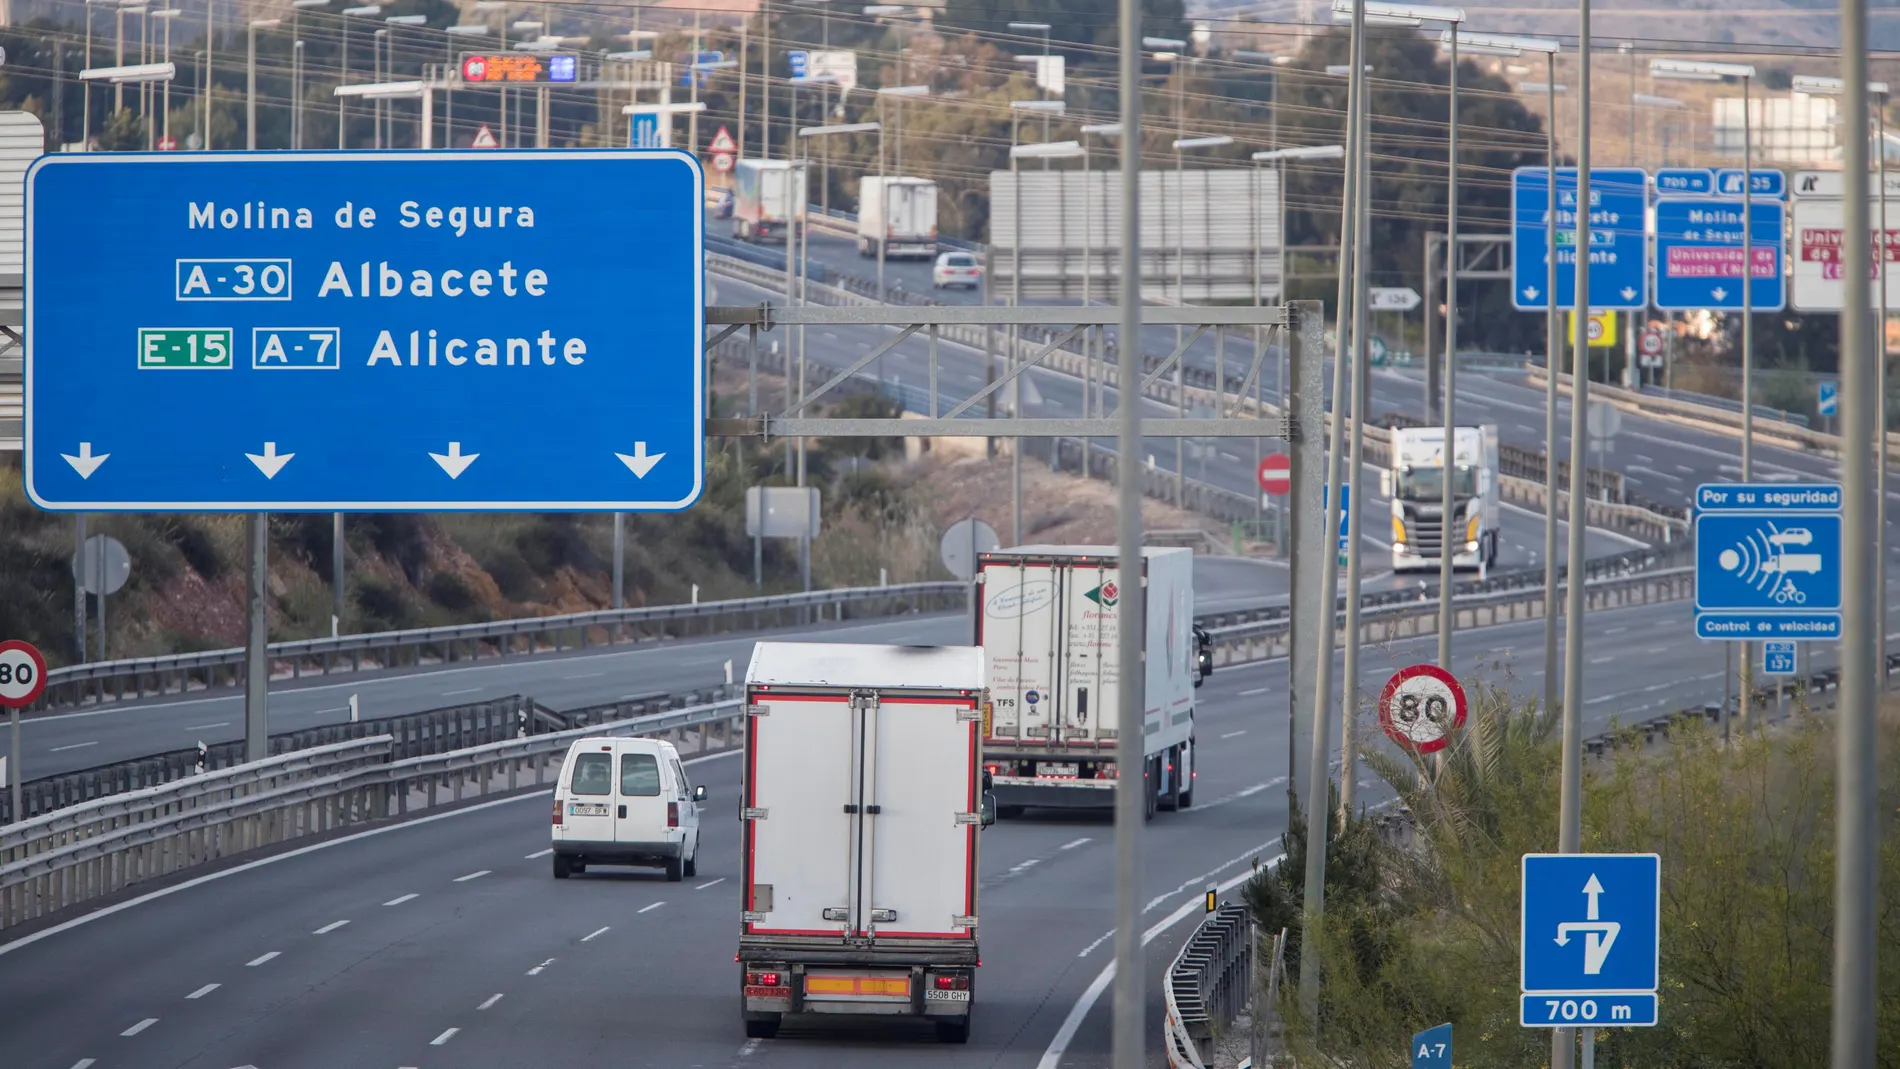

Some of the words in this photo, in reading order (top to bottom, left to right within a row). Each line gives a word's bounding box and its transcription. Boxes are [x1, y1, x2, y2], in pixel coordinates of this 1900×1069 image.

[1663, 178, 1687, 188] 700
[1690, 179, 1702, 188] m
[190, 202, 312, 228] Molina
[336, 202, 375, 228] de
[400, 201, 534, 237] Segura
[1684, 230, 1700, 240] de
[1757, 250, 1772, 260] de
[1810, 248, 1830, 259] de
[1670, 264, 1716, 274] Murcia
[184, 264, 286, 296] A-30
[318, 261, 548, 297] Albacete
[144, 334, 227, 363] E-15
[260, 334, 334, 363] A-7
[367, 330, 586, 366] Alicante
[1703, 490, 1728, 503] Por
[1737, 492, 1754, 503] su
[1764, 490, 1838, 506] seguridad
[1706, 622, 1750, 632] Control
[1758, 622, 1772, 632] de
[1780, 622, 1836, 632] velocidad
[1771, 660, 1790, 669] 137
[0, 663, 32, 684] 80
[1400, 694, 1448, 722] 80
[928, 991, 948, 999] 5508
[1546, 1000, 1598, 1020] 700
[1612, 1004, 1631, 1020] m
[1418, 1044, 1446, 1058] A-7
